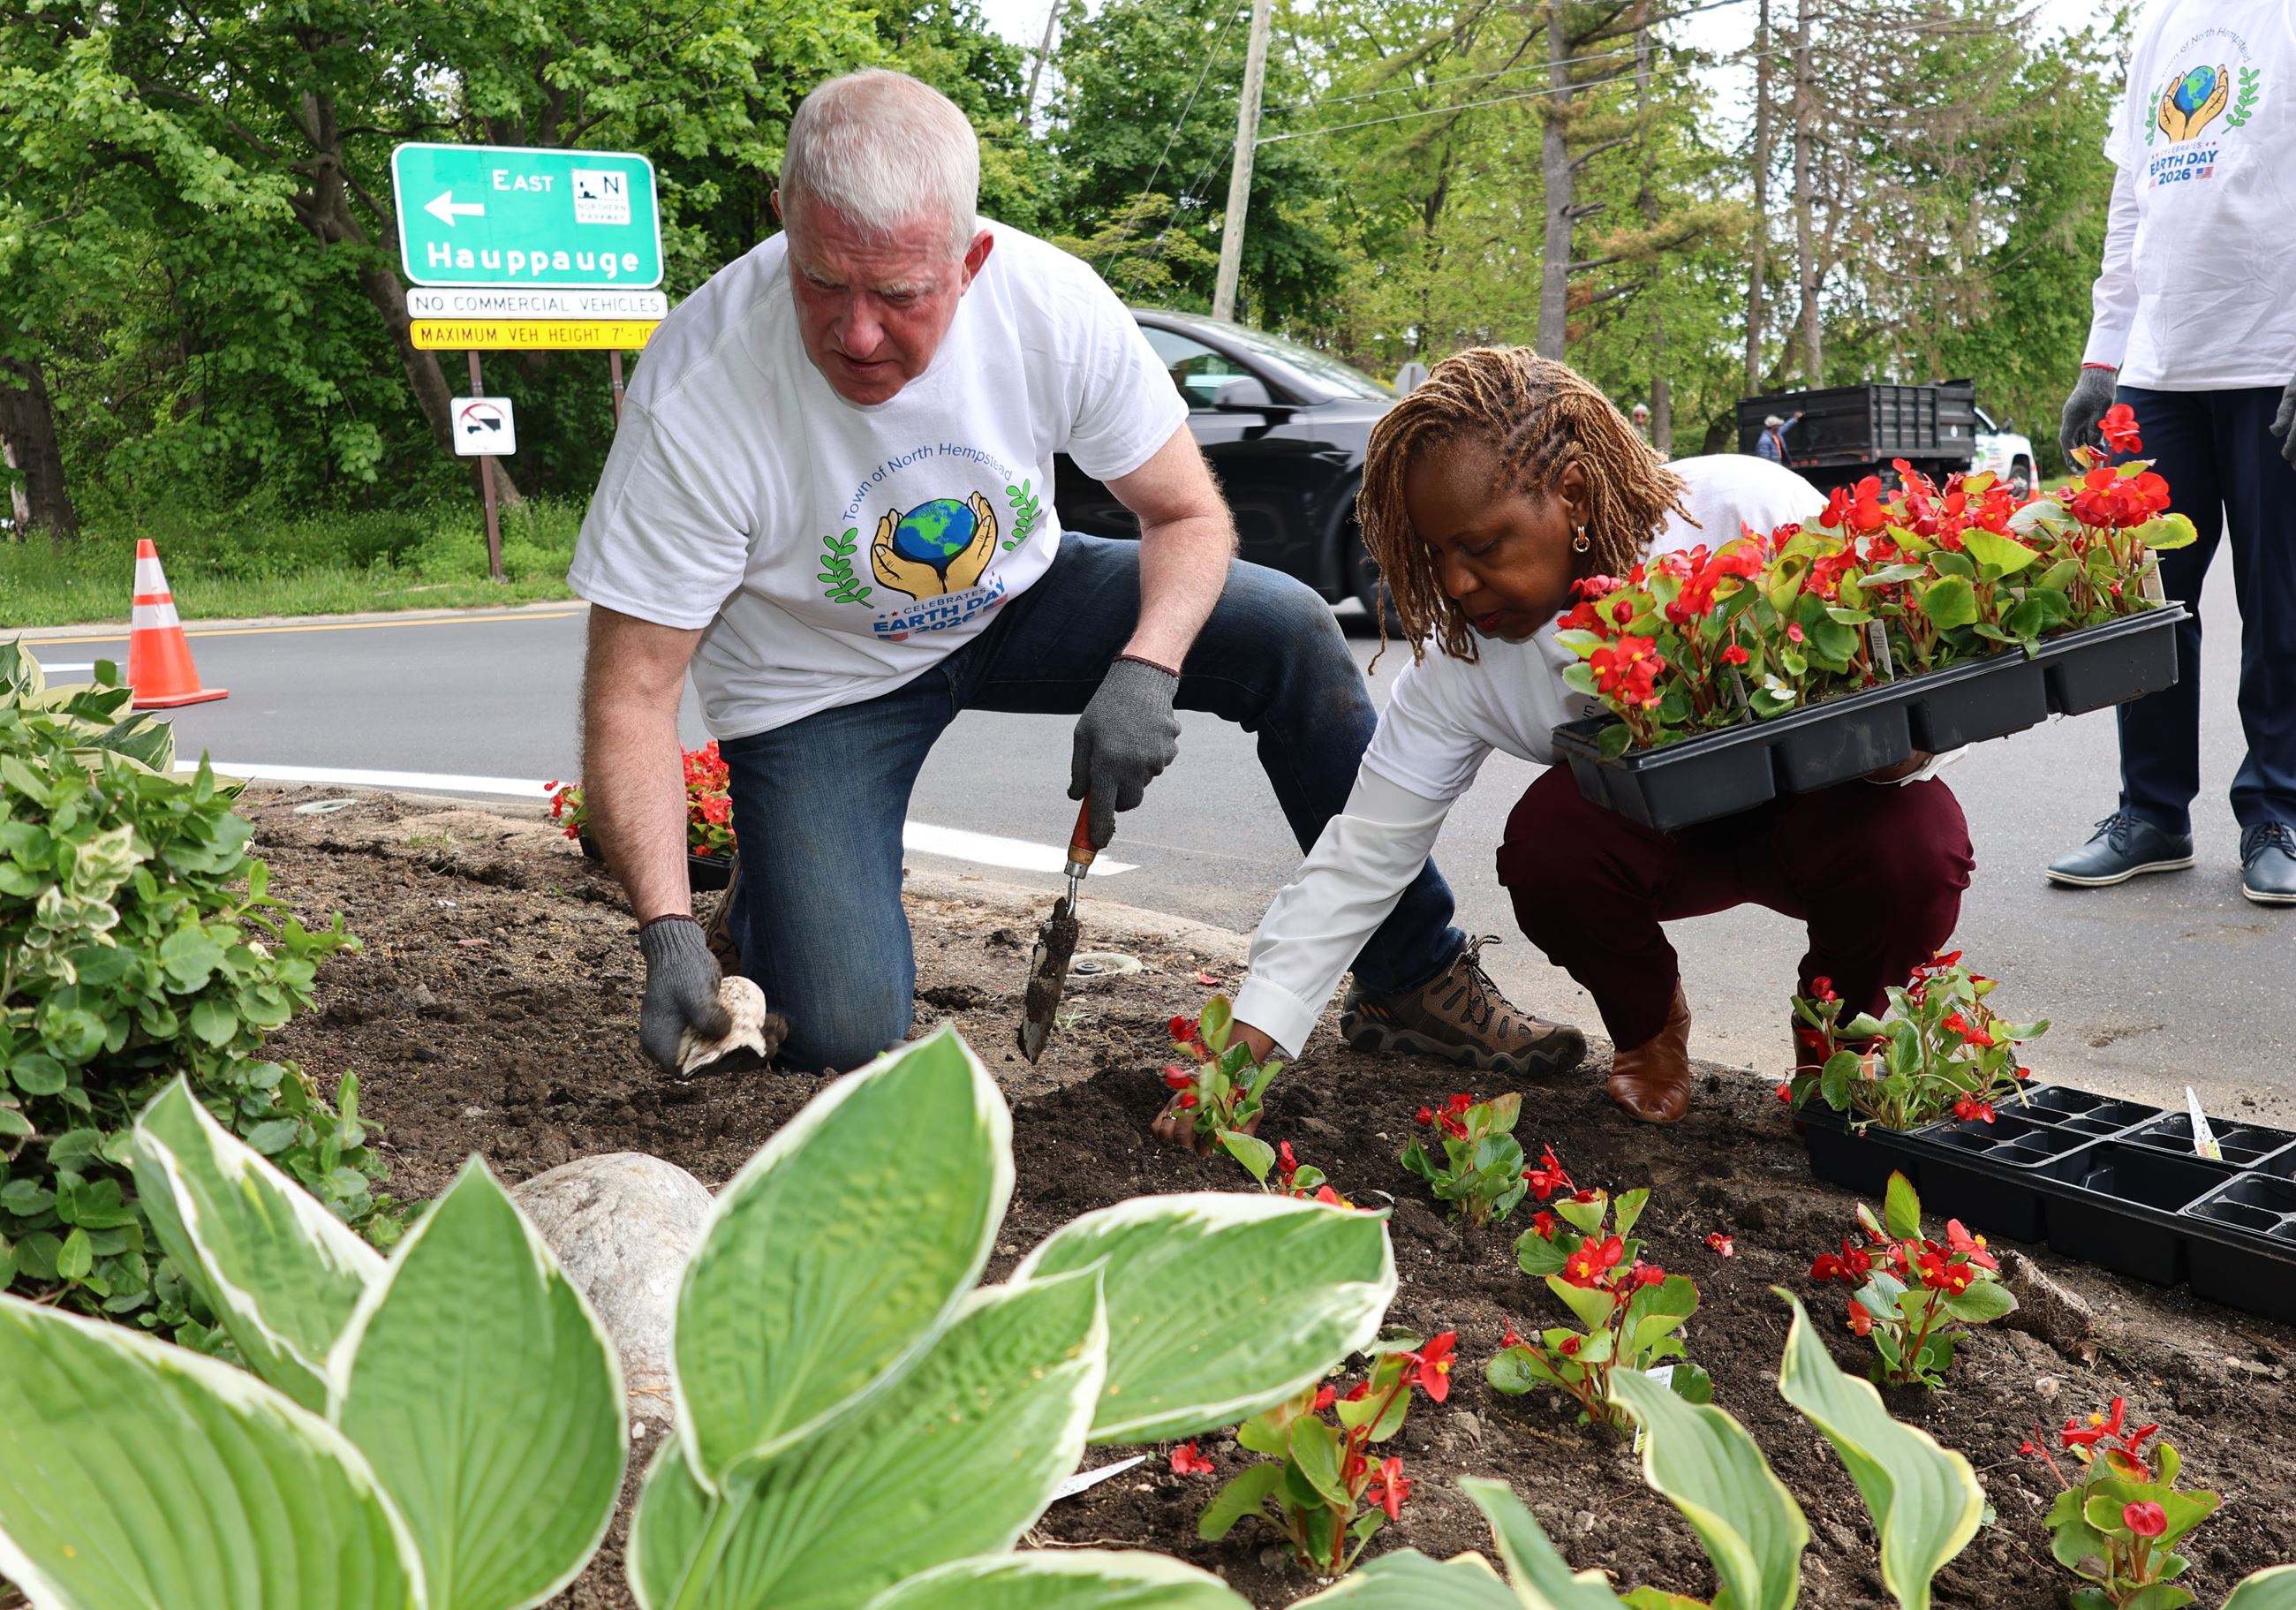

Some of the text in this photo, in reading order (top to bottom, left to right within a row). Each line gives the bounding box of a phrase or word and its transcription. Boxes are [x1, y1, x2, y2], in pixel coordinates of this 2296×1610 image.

[2150, 149, 2219, 177] EARTH DAY
[492, 169, 554, 192] EAST
[603, 176, 619, 194] N
[2158, 168, 2192, 185] 2026
[427, 241, 638, 280] Hauppauge
[415, 295, 660, 313] NO COMMERCIAL VEHICLES
[420, 328, 498, 342] MAXIMUM
[508, 328, 539, 341] VEH
[548, 328, 600, 342] HEIGHT
[842, 442, 1013, 521] Town of North Hempstead
[873, 575, 1006, 632] EARTH DAY
[903, 587, 986, 615] CELEBRATES
